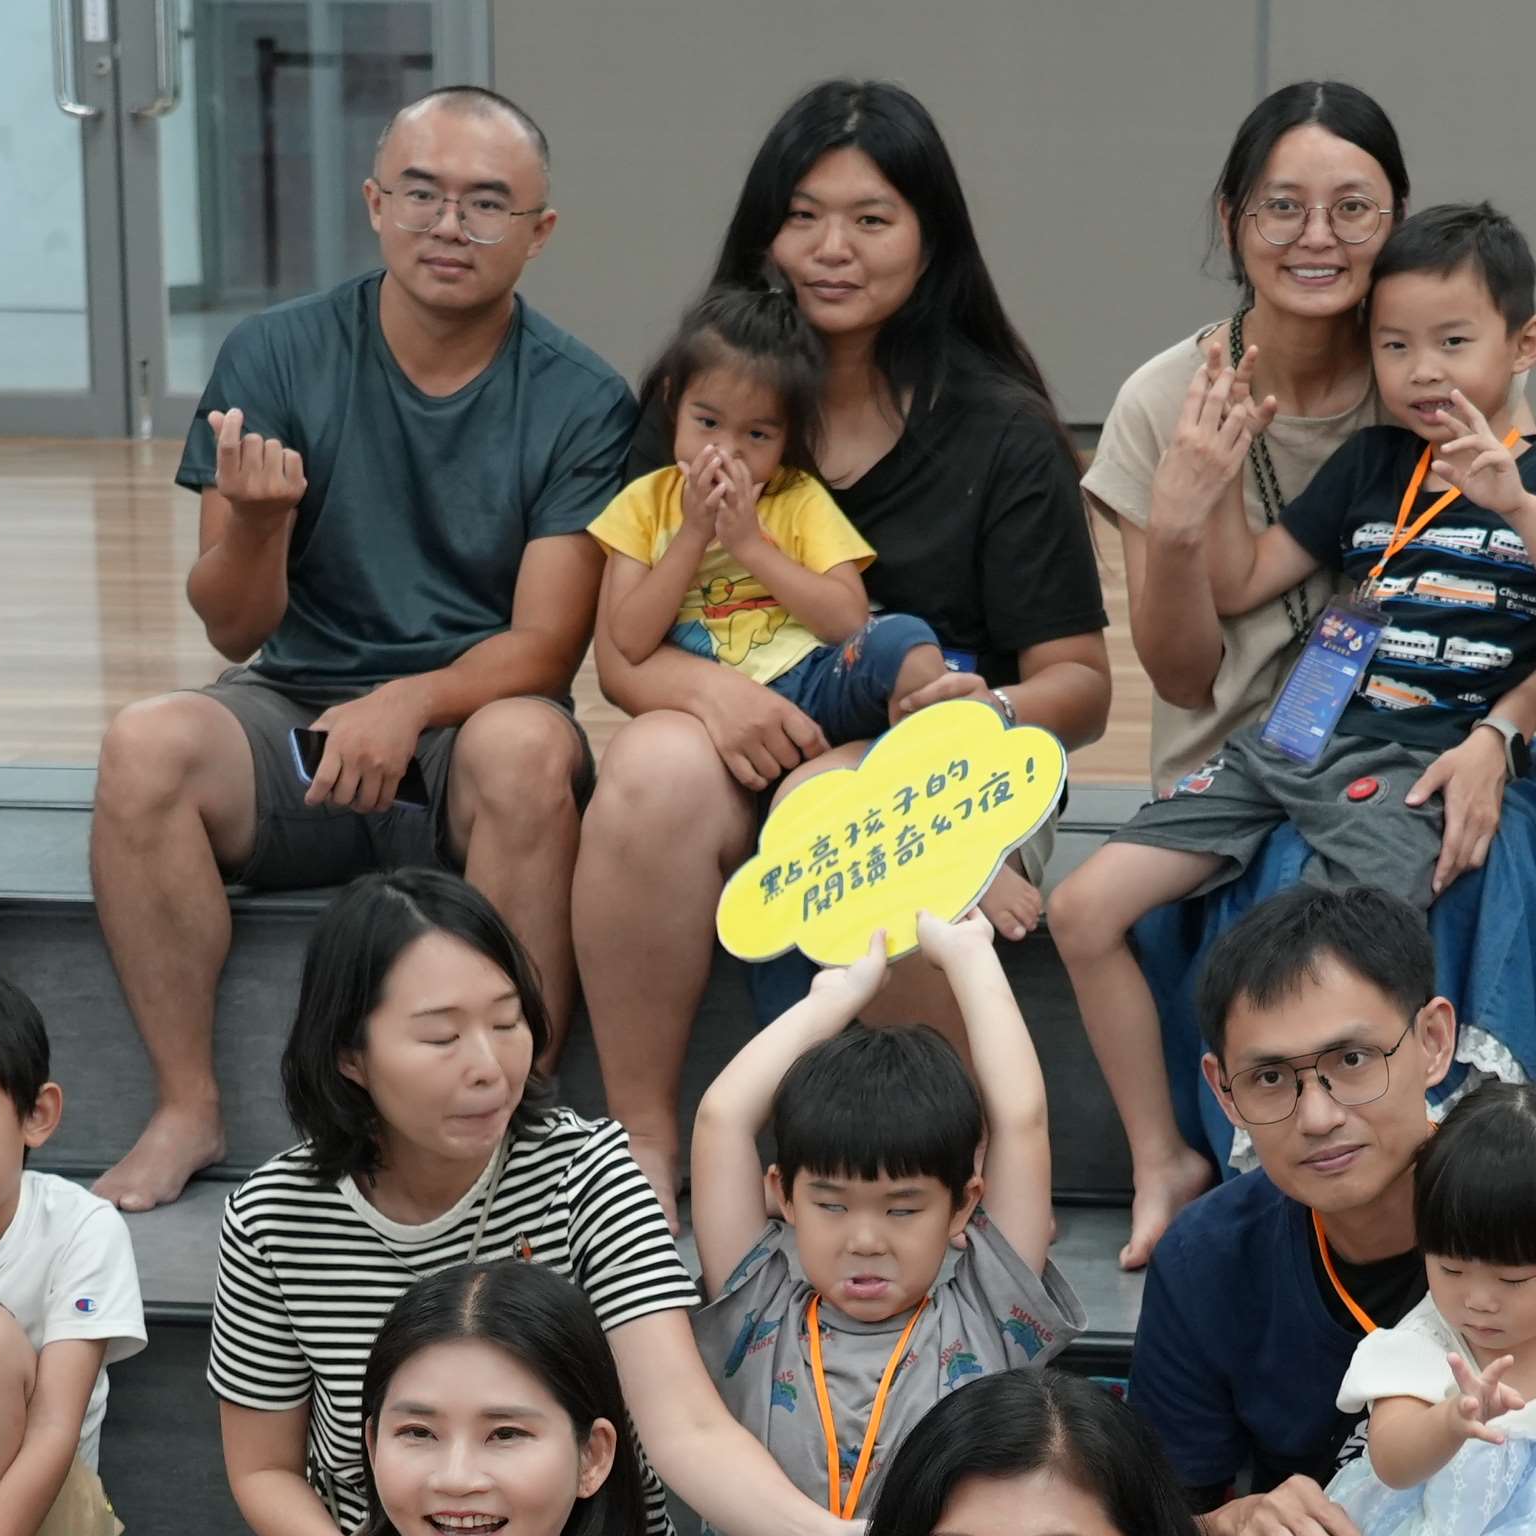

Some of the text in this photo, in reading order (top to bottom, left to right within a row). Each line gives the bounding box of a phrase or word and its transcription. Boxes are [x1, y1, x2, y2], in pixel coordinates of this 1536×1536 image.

[759, 758, 969, 905] 點亮孩子的
